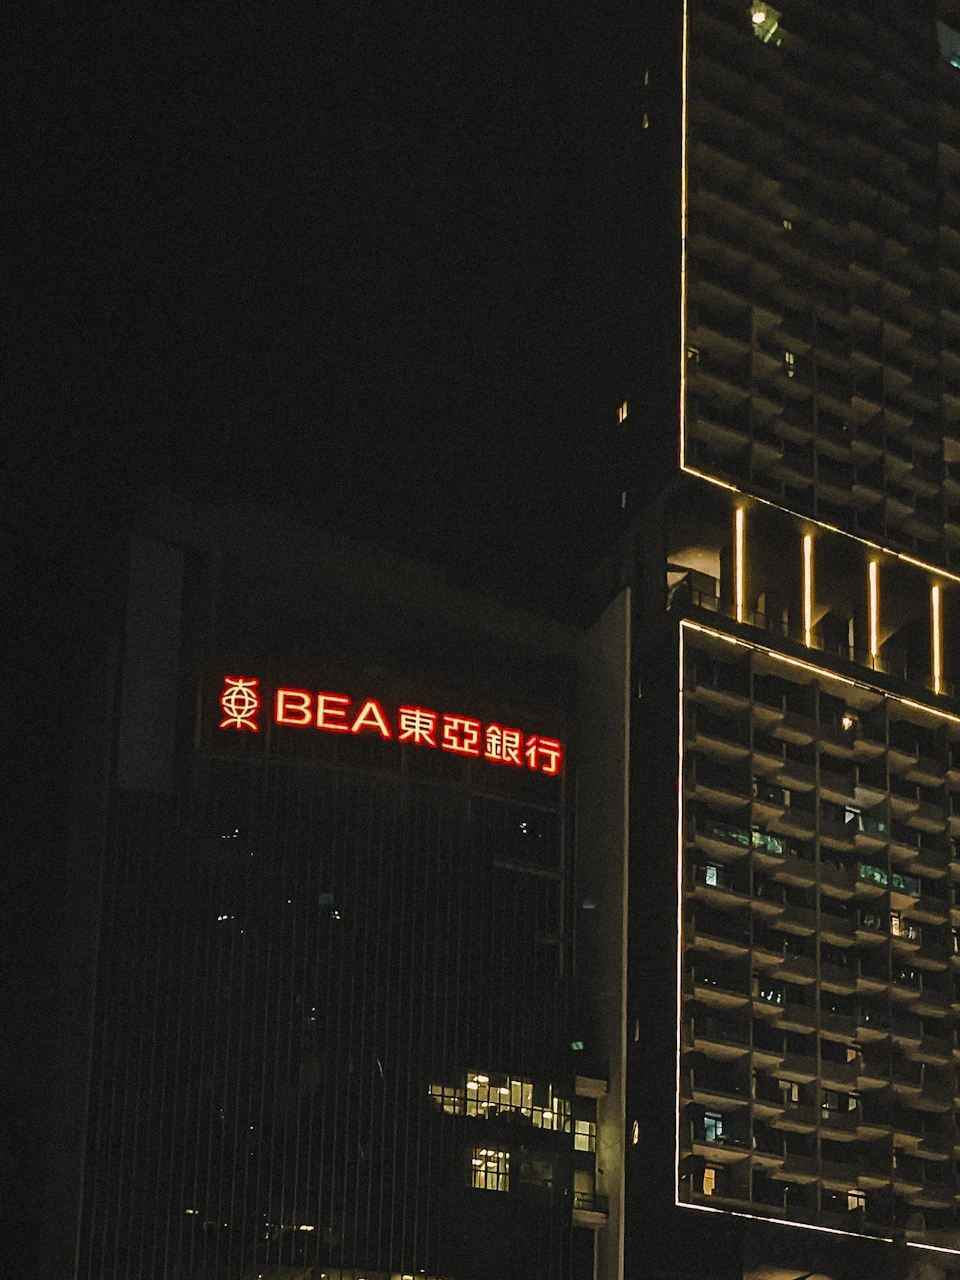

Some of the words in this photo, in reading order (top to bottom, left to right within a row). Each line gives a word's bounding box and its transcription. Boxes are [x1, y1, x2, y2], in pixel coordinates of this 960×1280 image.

[274, 688, 390, 738] BEA
[399, 707, 563, 775] 東亞銀行
